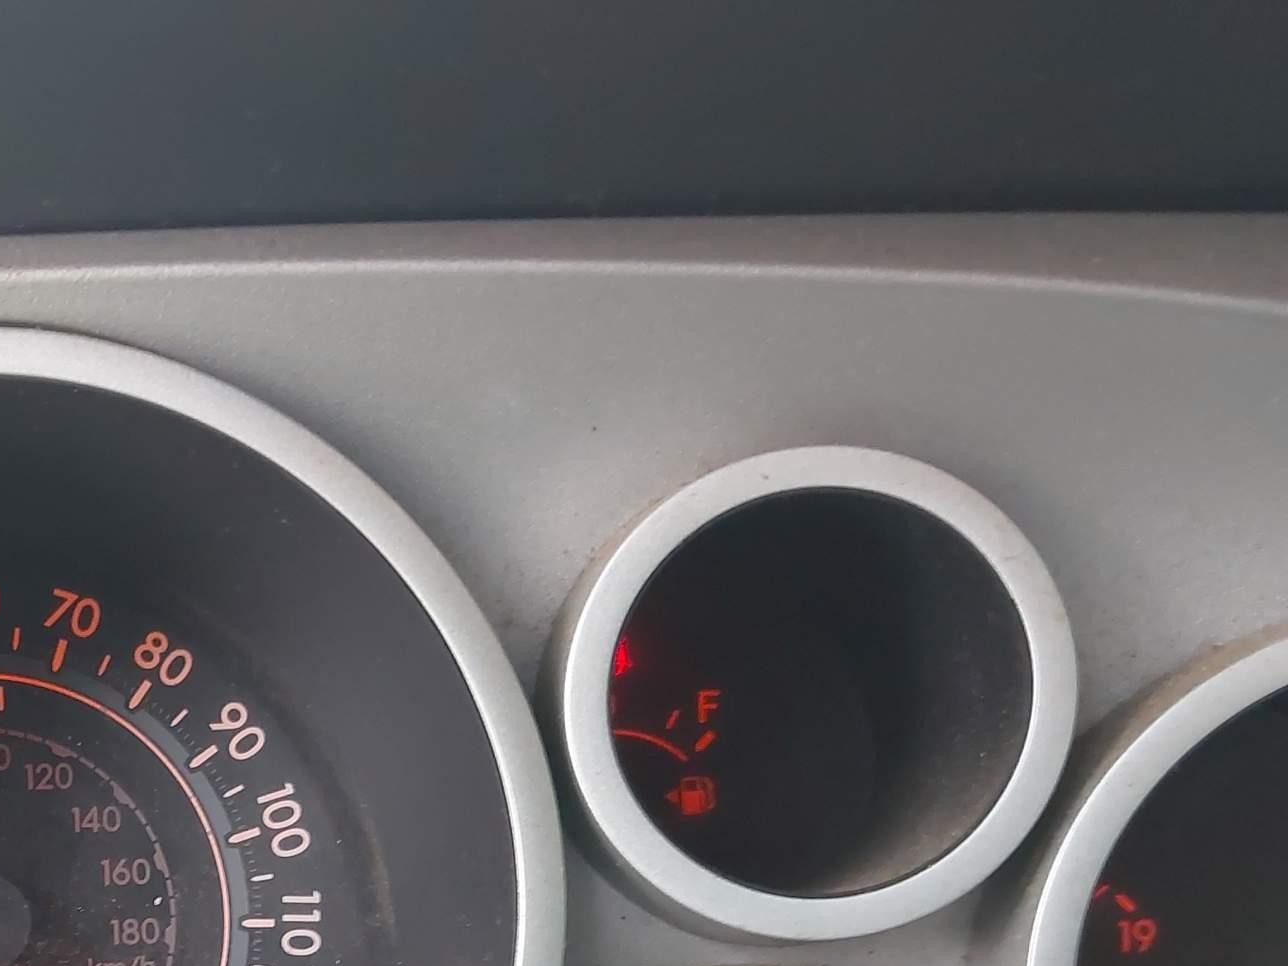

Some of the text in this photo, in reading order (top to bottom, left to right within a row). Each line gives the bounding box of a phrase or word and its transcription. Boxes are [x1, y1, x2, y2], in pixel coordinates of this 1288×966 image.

[43, 589, 101, 639] 70
[132, 629, 193, 687] 80
[697, 690, 720, 723] F
[210, 703, 265, 761] 90
[24, 762, 74, 791] 120
[71, 806, 122, 832] 140
[256, 781, 310, 859] 100
[101, 859, 151, 886] 160
[110, 919, 160, 945] 180
[281, 889, 321, 958] 110
[1117, 917, 1157, 954] 19
